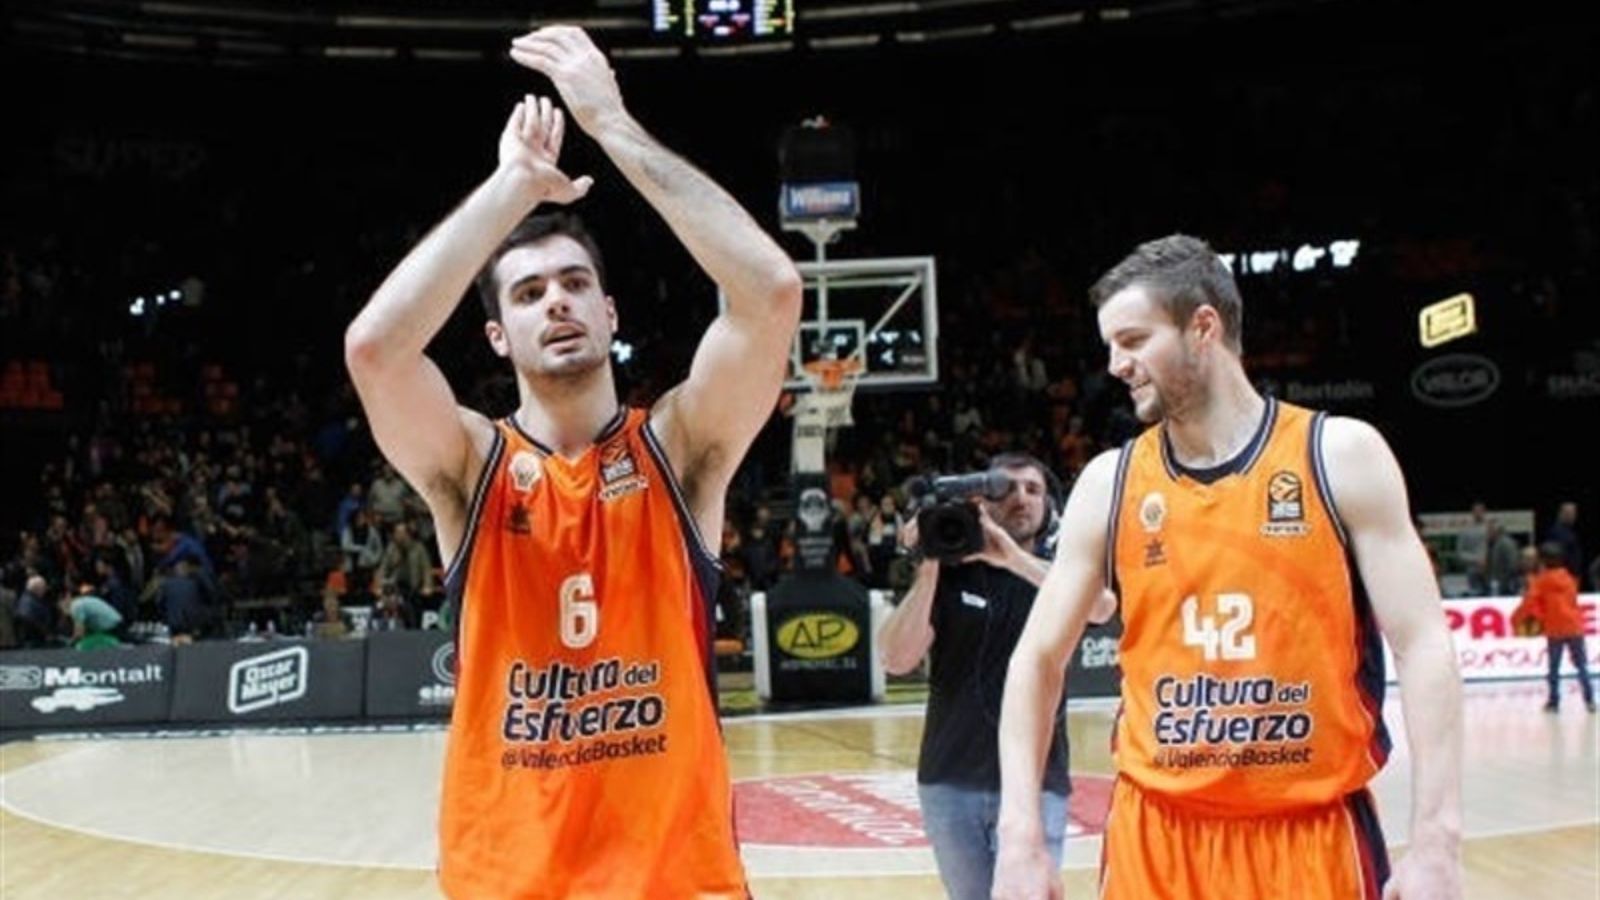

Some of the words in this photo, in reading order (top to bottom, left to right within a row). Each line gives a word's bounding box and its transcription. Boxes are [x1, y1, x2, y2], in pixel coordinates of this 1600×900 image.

[558, 574, 599, 649] 6
[1181, 592, 1256, 661] 42
[44, 664, 164, 686] Montalt
[240, 675, 299, 701] Mayer
[244, 660, 294, 685] Oscar
[508, 660, 620, 701] Cultura
[623, 662, 658, 688] del
[1155, 676, 1275, 708] Cultura
[1276, 683, 1309, 704] del
[503, 695, 664, 743] Esfuerzo
[1155, 708, 1312, 744] Esfuerzo
[501, 734, 667, 770] @ValenciaBasket
[1153, 747, 1313, 770] @ValenciaBasket
